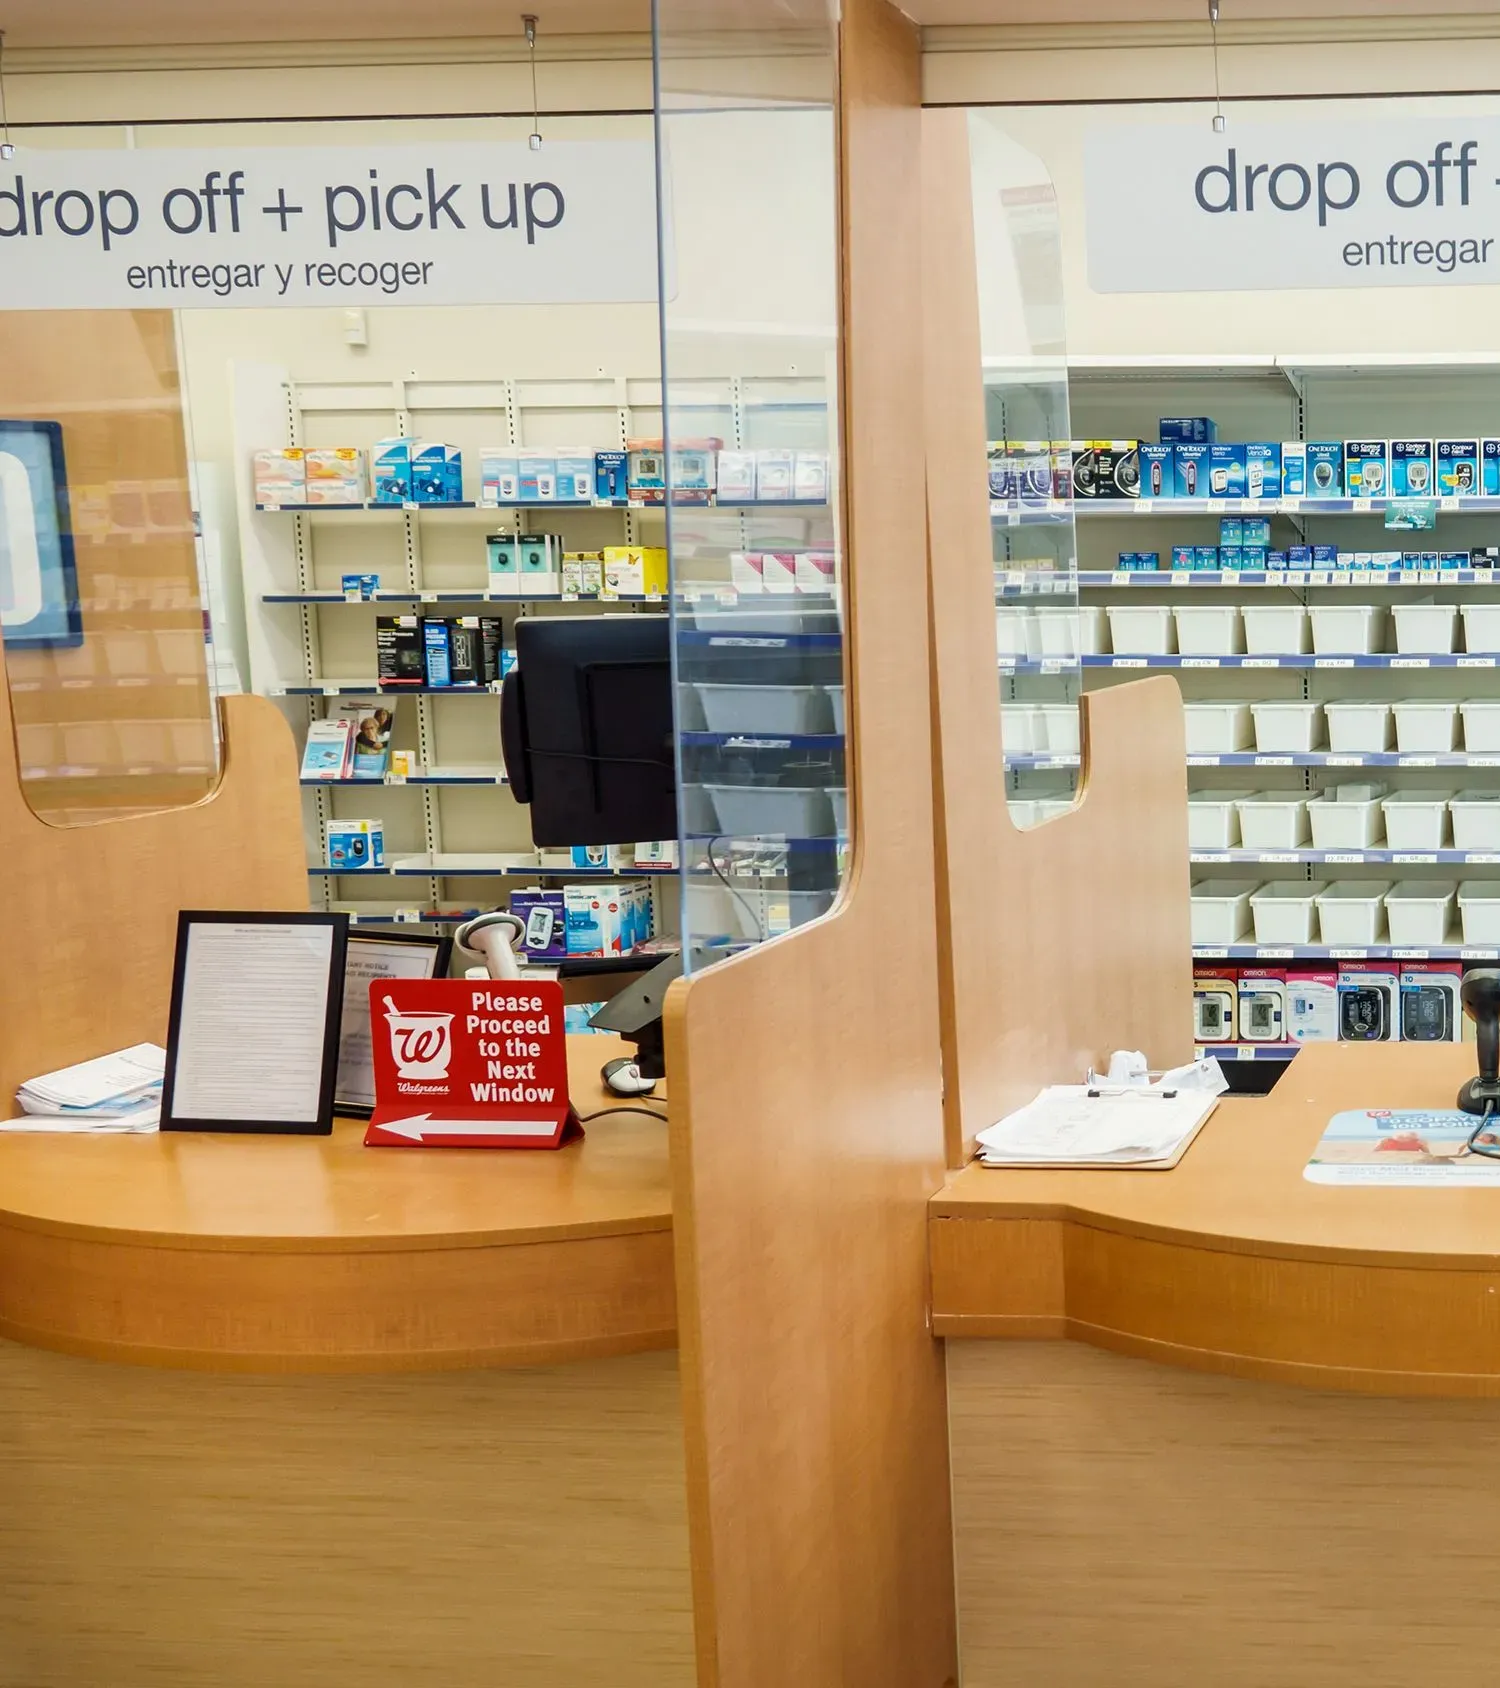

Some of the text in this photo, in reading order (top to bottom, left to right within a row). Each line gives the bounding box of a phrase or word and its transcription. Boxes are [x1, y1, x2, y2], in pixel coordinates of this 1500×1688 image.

[1195, 149, 1359, 226] drop
[1387, 141, 1477, 207] off
[0, 168, 564, 251] drop off + pick up
[1343, 235, 1493, 272] entregar
[127, 260, 433, 296] entregar y recoger
[473, 992, 542, 1012] Please
[467, 1015, 549, 1034] Proceed
[479, 1038, 540, 1057] to the
[488, 1061, 535, 1079] Next
[398, 1082, 450, 1096] Walgreens
[471, 1083, 554, 1102] Window
